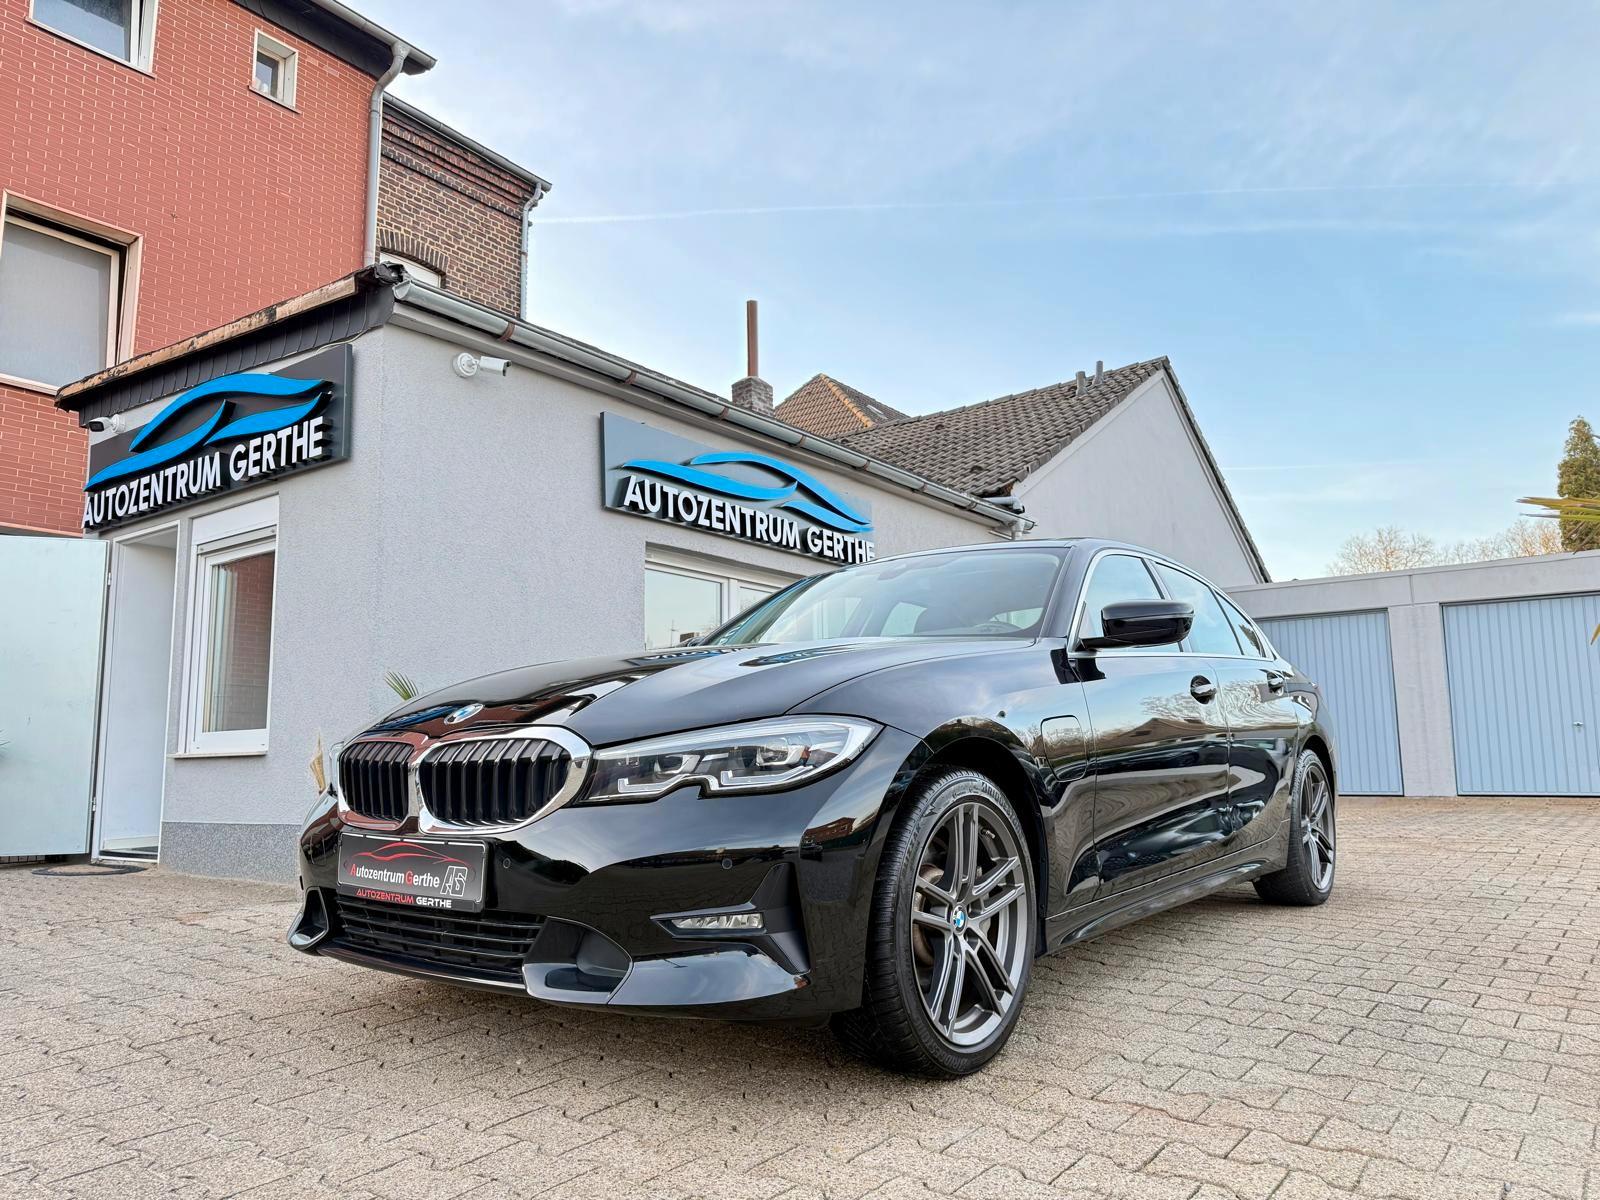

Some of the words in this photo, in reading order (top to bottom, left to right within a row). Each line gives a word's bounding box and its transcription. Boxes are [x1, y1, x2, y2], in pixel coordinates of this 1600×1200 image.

[82, 452, 221, 529] AUTOZENTRUM
[229, 416, 324, 482] GERTHE
[623, 475, 800, 549] AUTOZENTRUM
[806, 526, 875, 564] GERTHE
[350, 863, 404, 884] Autozentrum
[405, 870, 440, 888] Gerthe
[356, 888, 414, 904] AUTOZENTRUM
[416, 896, 452, 909] GERTHE
